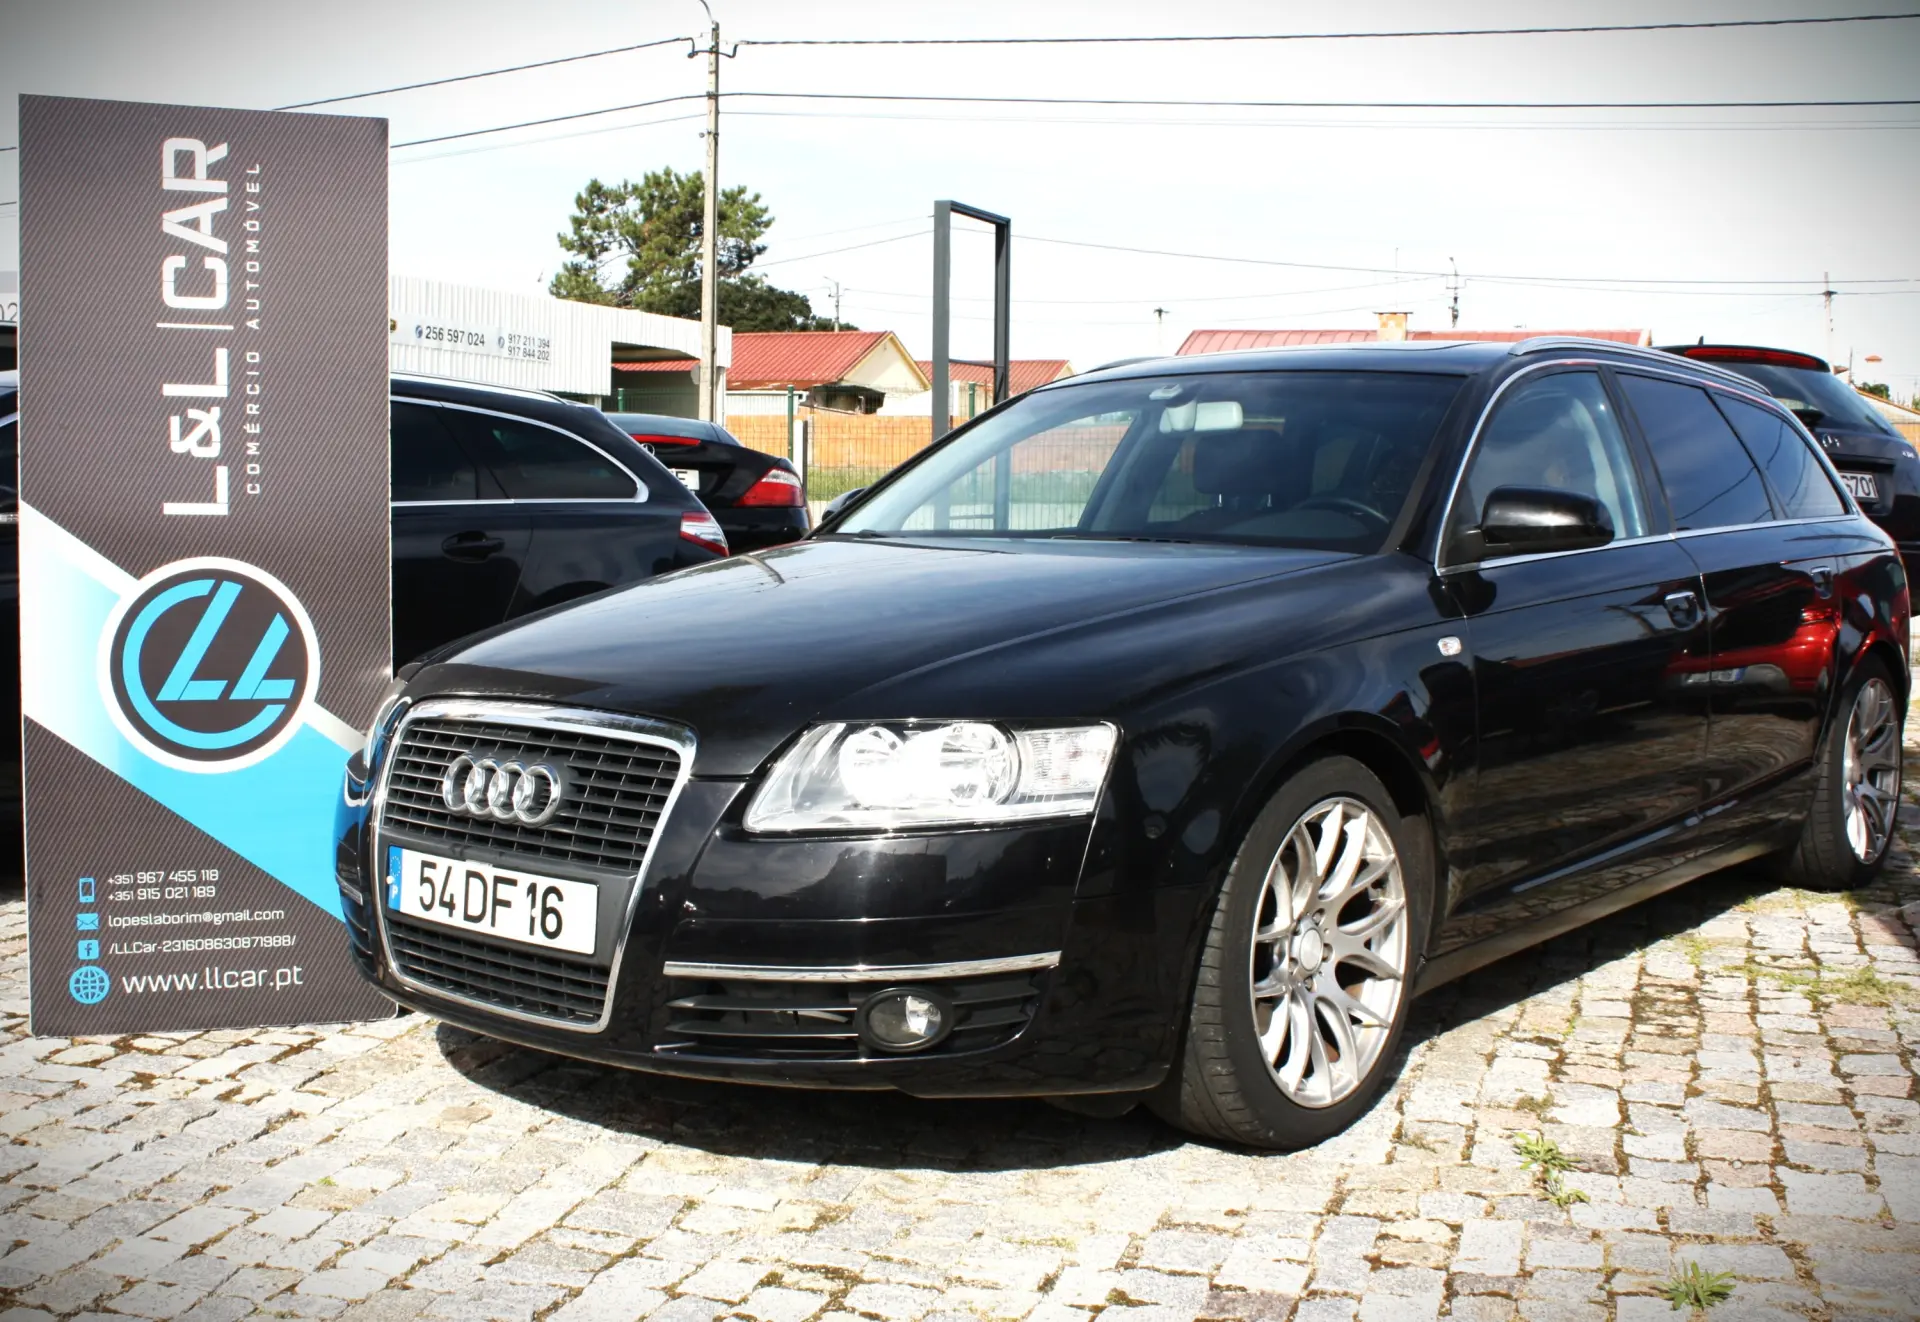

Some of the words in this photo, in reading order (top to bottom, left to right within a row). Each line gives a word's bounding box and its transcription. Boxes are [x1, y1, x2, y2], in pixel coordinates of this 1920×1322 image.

[162, 137, 228, 310] CAR
[246, 164, 260, 329] AUTOMÓVEL
[425, 325, 444, 341] 256
[447, 328, 465, 343] 597
[467, 331, 485, 346] 024
[508, 333, 521, 345] 917
[523, 335, 535, 347] 211
[508, 345, 521, 356] 917
[537, 349, 550, 360] 202
[246, 351, 260, 494] COMÉRCIO
[108, 874, 134, 885] +351
[137, 871, 165, 884] 967
[168, 870, 197, 882] 455
[201, 869, 219, 881] 118
[108, 890, 134, 901] +351
[137, 888, 161, 900] 915
[165, 886, 189, 899] 021
[192, 885, 216, 898] 189
[108, 909, 285, 928] lopeslaborim@gmail.com
[122, 965, 304, 993] www.llcar.pt
